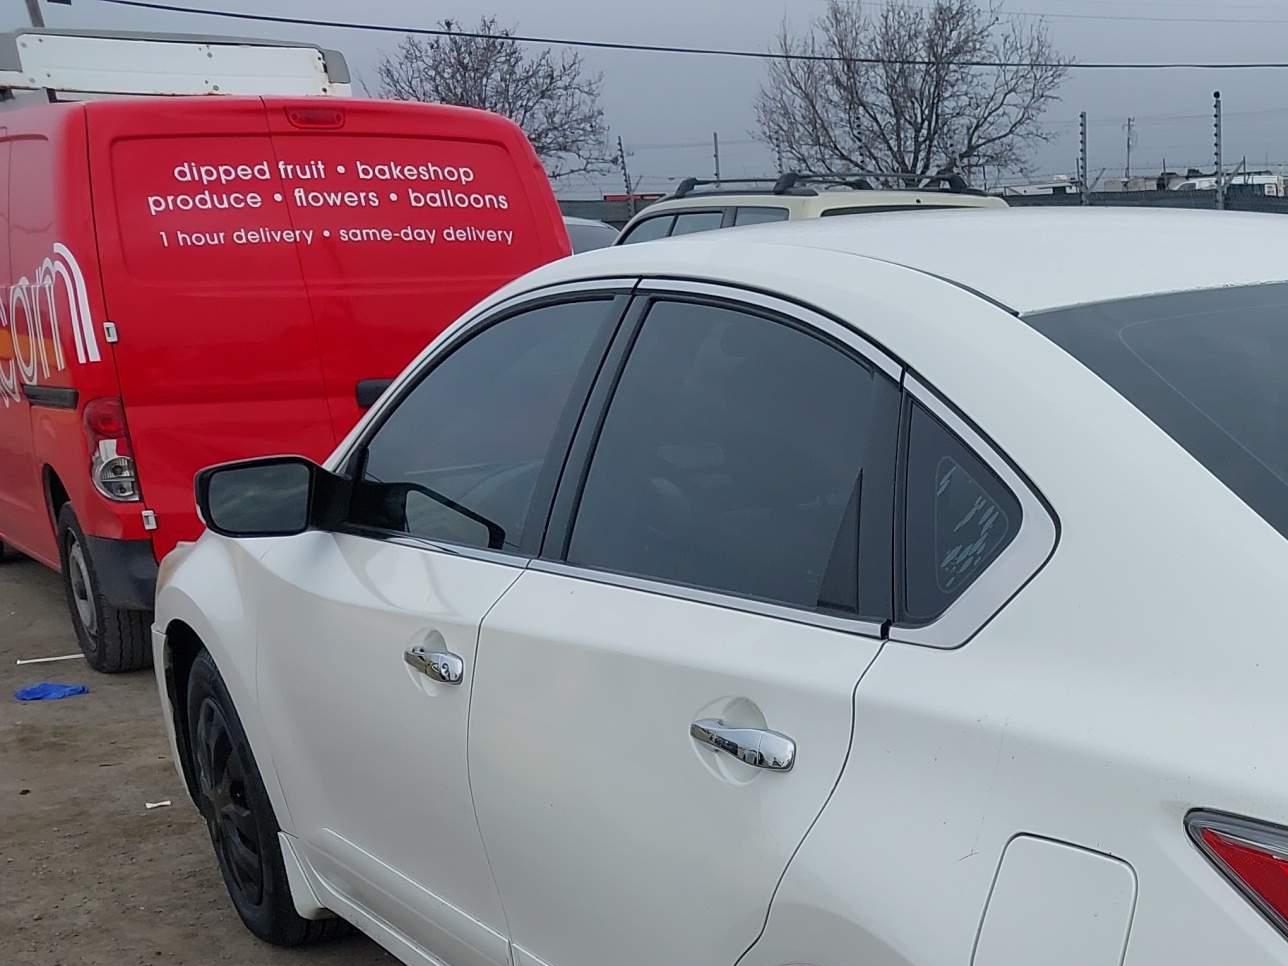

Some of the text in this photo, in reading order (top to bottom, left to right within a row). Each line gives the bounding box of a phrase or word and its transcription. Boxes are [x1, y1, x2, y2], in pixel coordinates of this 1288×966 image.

[173, 160, 474, 185] dipped fruit bakeshop
[147, 188, 509, 216] produce flowers balloons
[159, 226, 513, 247] 1 hour delivery same-day delivery
